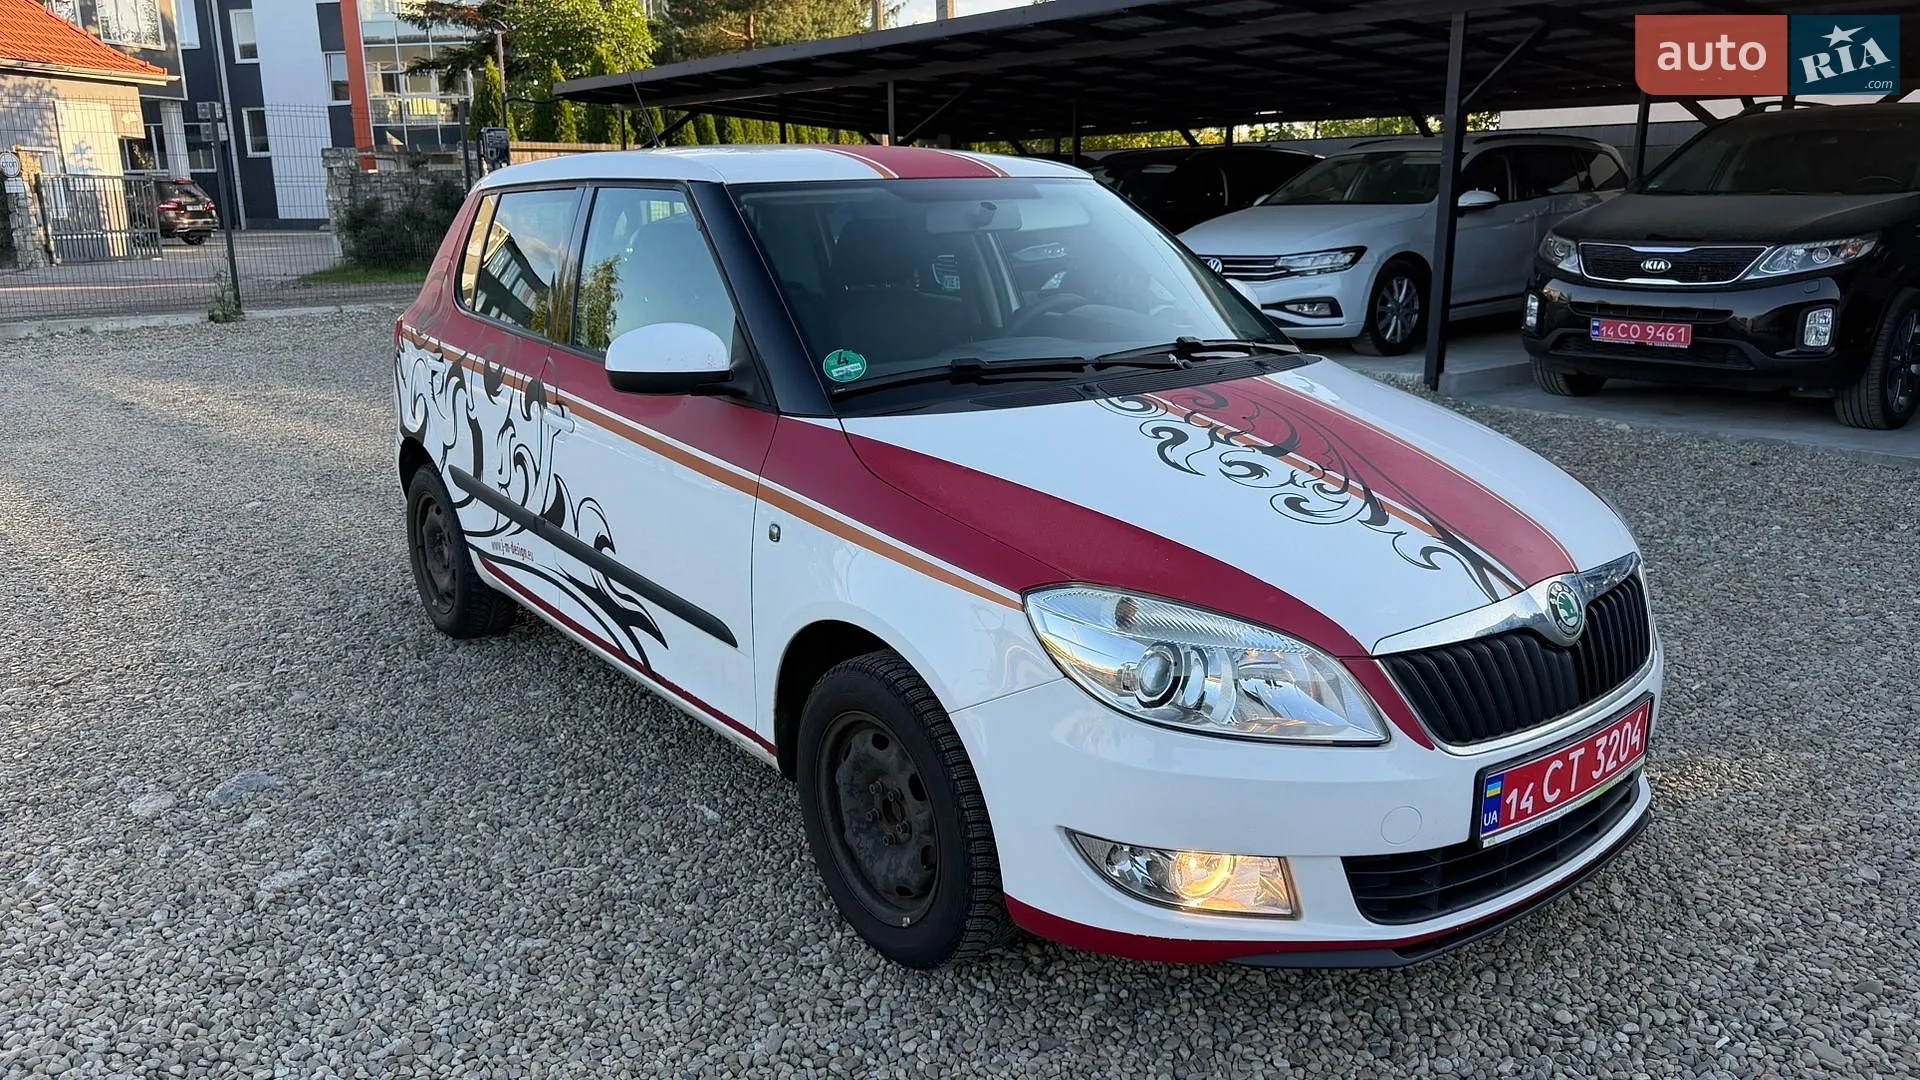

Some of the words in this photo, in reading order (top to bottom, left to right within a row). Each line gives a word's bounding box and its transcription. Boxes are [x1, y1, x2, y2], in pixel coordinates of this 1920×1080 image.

[1645, 260, 1665, 270] KIA
[1601, 326, 1614, 337] 14
[1618, 323, 1640, 338] CO
[1646, 325, 1685, 342] 9461
[837, 351, 849, 365] 4
[1483, 810, 1498, 826] UA
[1506, 782, 1535, 820] 14
[1542, 747, 1585, 803] CT
[1591, 711, 1643, 780] 3204
